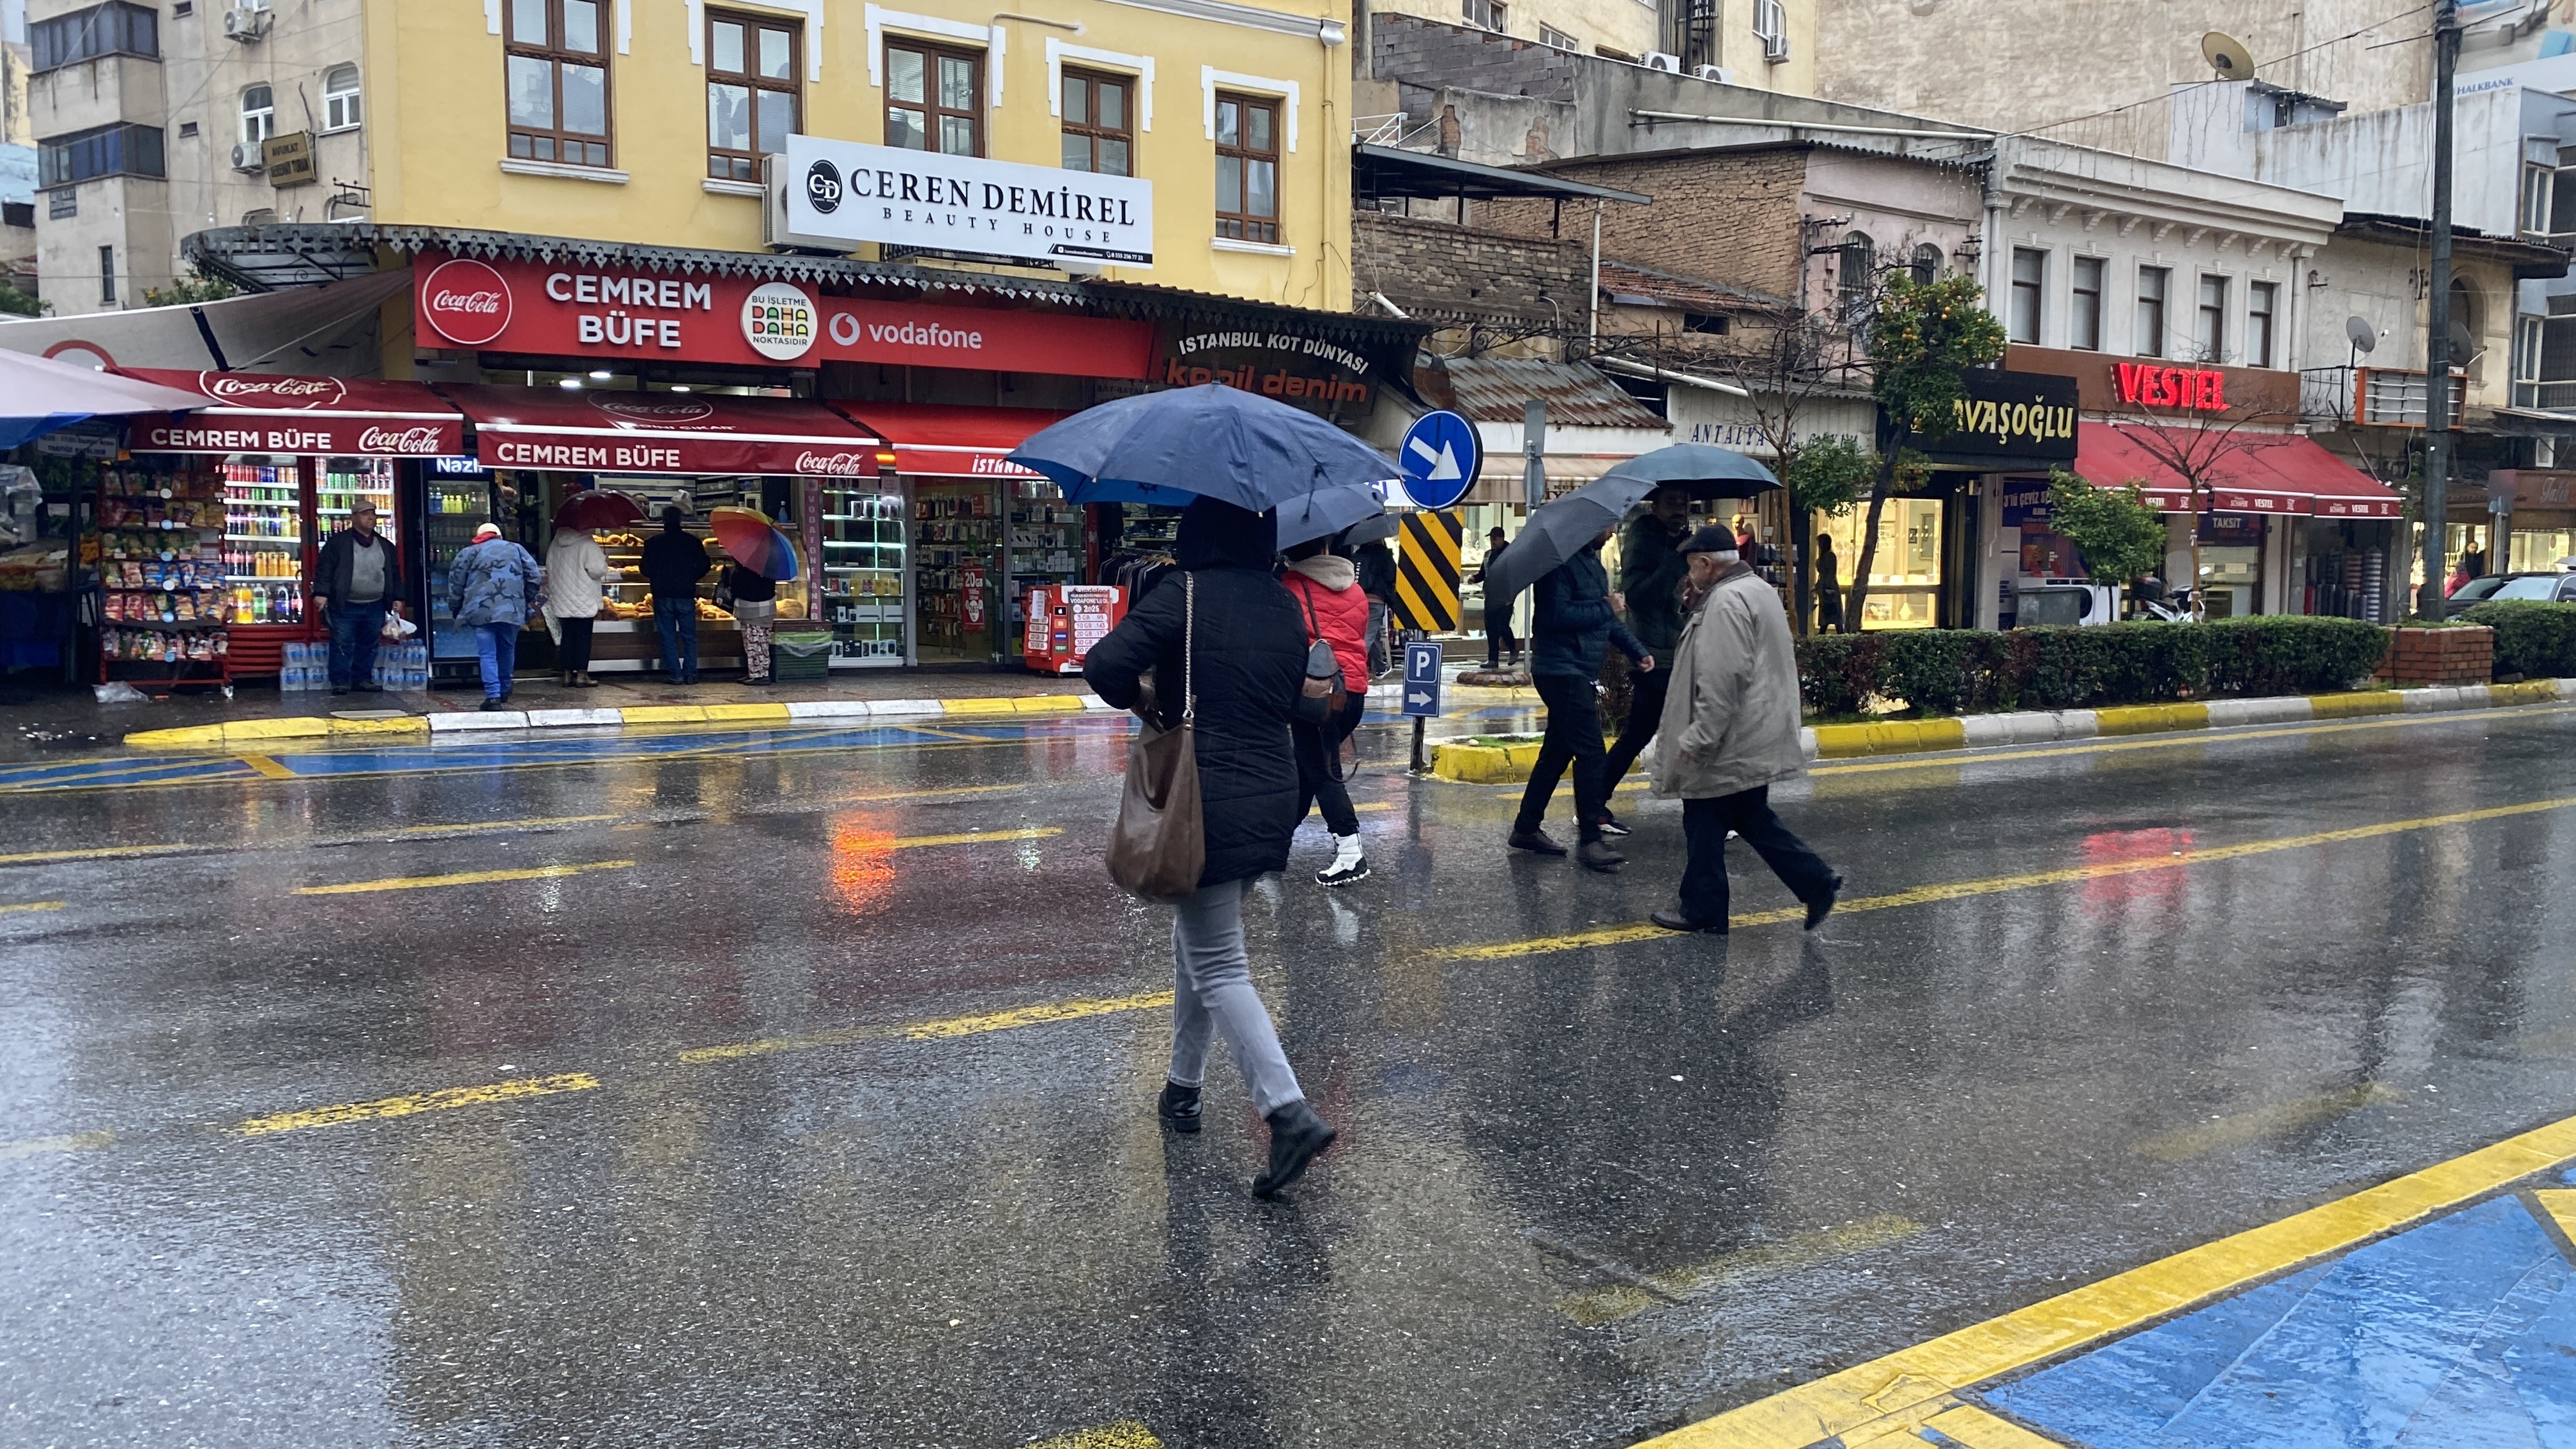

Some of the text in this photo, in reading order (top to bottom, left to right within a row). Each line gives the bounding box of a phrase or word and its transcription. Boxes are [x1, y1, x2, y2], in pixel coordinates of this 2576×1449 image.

[2457, 77, 2515, 95] HALKBANK
[850, 168, 1135, 226] CEREN DEMİREL
[882, 207, 1110, 243] BEAUTY HOUSE
[433, 289, 502, 316] Coca-Cola
[546, 273, 711, 310] CEMREM
[752, 295, 806, 307] BU İŞLETME
[752, 305, 808, 321] DAHA
[579, 311, 681, 348] BÜFE
[752, 321, 808, 337] DAHA
[753, 336, 808, 347] NOKTASIDIR
[868, 322, 983, 349] vodafone
[1179, 332, 1369, 375] ISTANBUL KOT DÜNYASI
[213, 377, 335, 396] Coca-Cola
[1262, 369, 1368, 402] denim
[2111, 362, 2229, 411] VESTEL
[1952, 395, 2073, 445] AVAŞOĞLU
[151, 427, 332, 449] CEMREM BÜFE
[358, 425, 443, 453] Coca-Cola
[1690, 423, 1764, 446] ANTALYA
[497, 442, 680, 468] CEMREM BÜFE
[795, 450, 863, 476] Coca-Cola
[972, 454, 1040, 474] İSTANBU
[2254, 498, 2274, 509] VESTEL
[2352, 504, 2369, 514] VESTEL
[2212, 517, 2241, 528] TAKSİT
[965, 572, 983, 587] 20 GB
[1416, 651, 1430, 677] P
